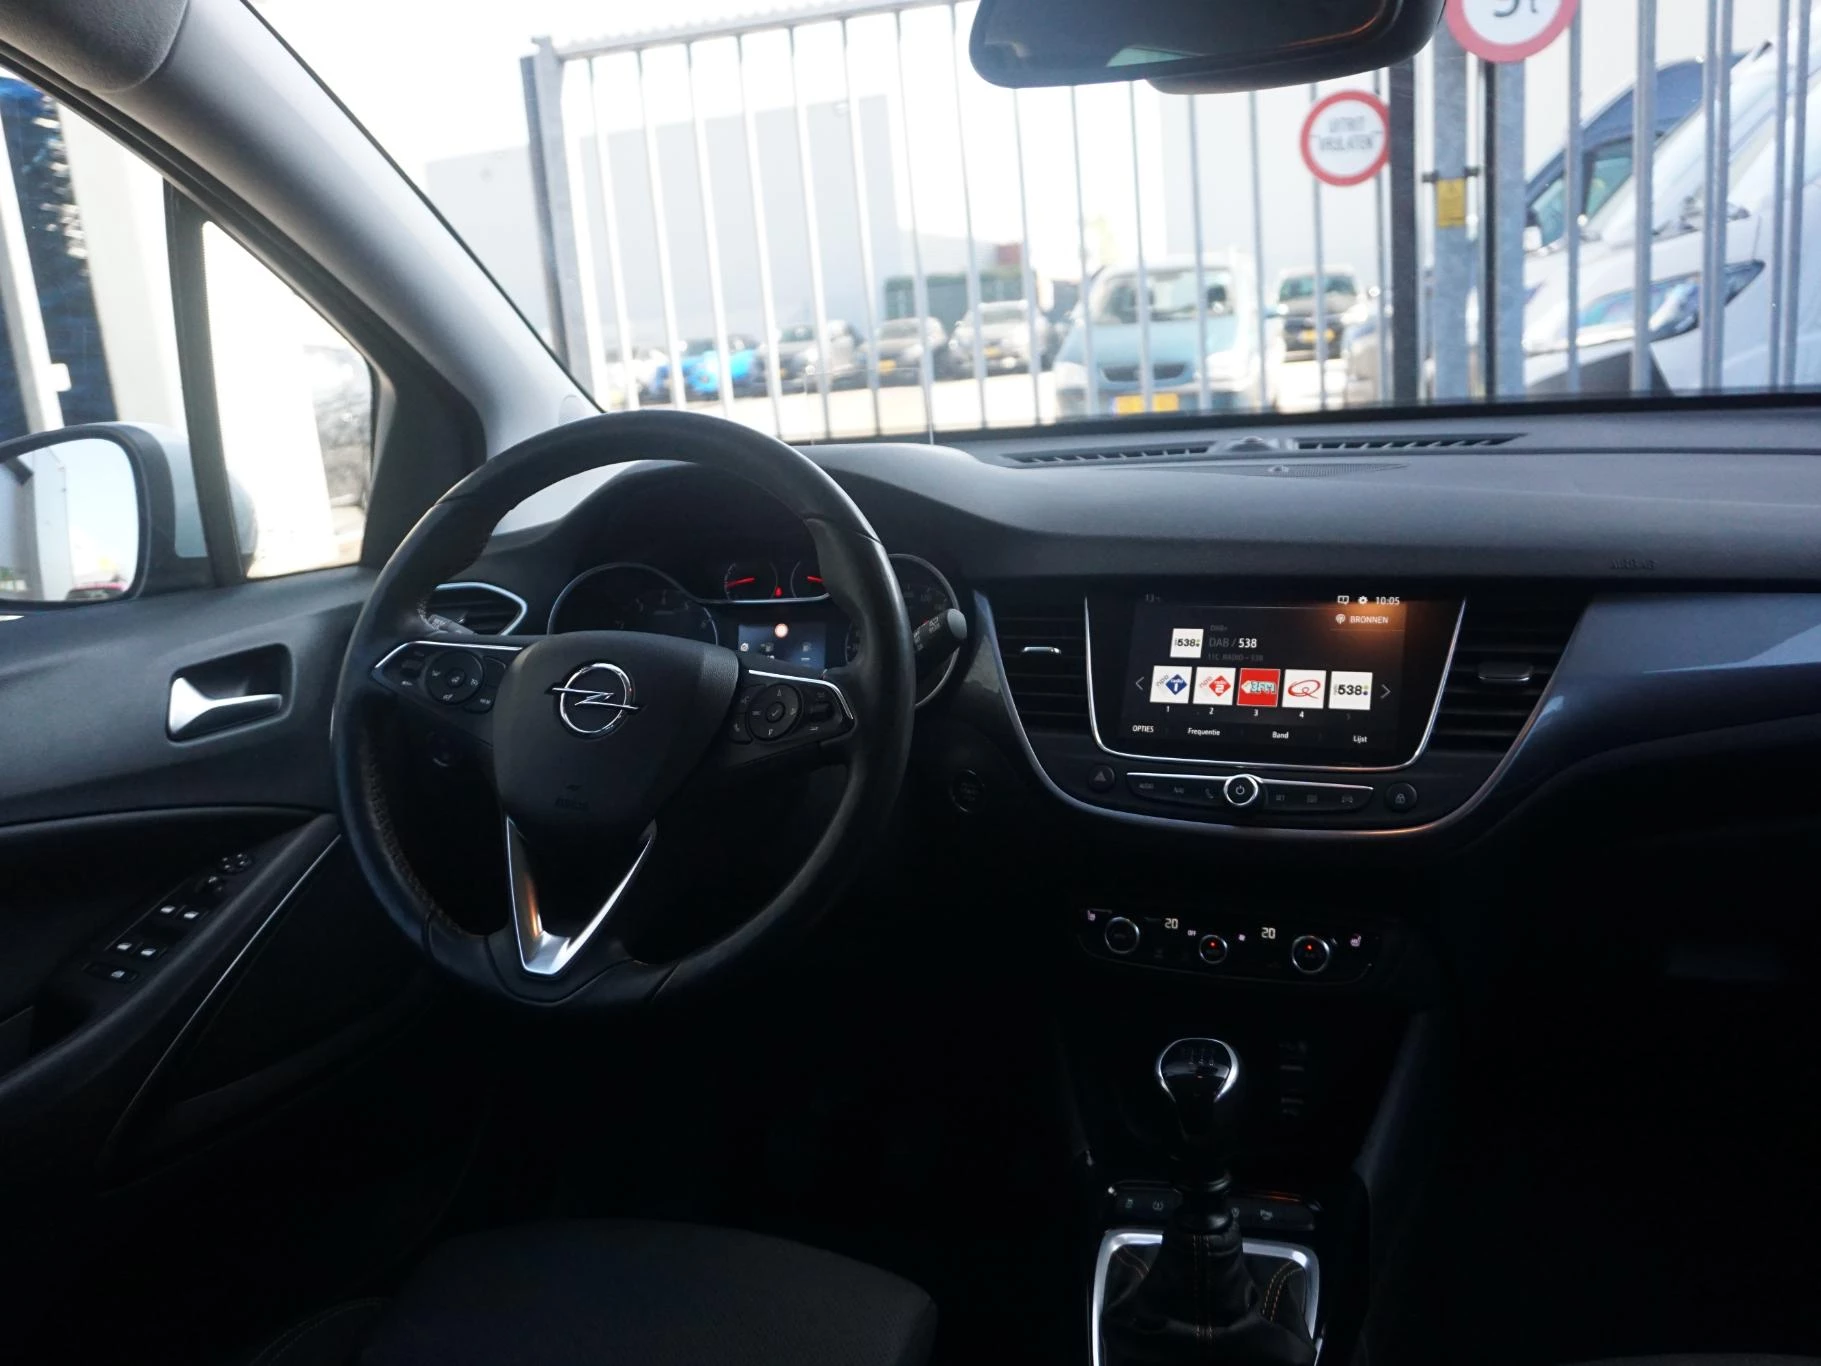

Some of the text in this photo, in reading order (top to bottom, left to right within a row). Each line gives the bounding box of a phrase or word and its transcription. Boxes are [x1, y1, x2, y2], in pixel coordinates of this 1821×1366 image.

[1375, 596, 1400, 606] 10:05
[1349, 615, 1389, 624] BRONNEN
[1177, 638, 1196, 647] 538
[1208, 637, 1230, 648] DAB
[1238, 637, 1258, 649] 538
[1214, 684, 1225, 693] 2
[1337, 684, 1362, 696] 538
[1209, 707, 1214, 715] 2
[1253, 709, 1259, 717] 3
[1299, 711, 1304, 719] 4
[1132, 725, 1155, 733] OPTIES
[1187, 727, 1221, 737] Frequentie
[1272, 731, 1289, 739] Band
[1353, 735, 1368, 744] Lijst
[1164, 917, 1179, 930] 20
[1260, 926, 1276, 940] 20
